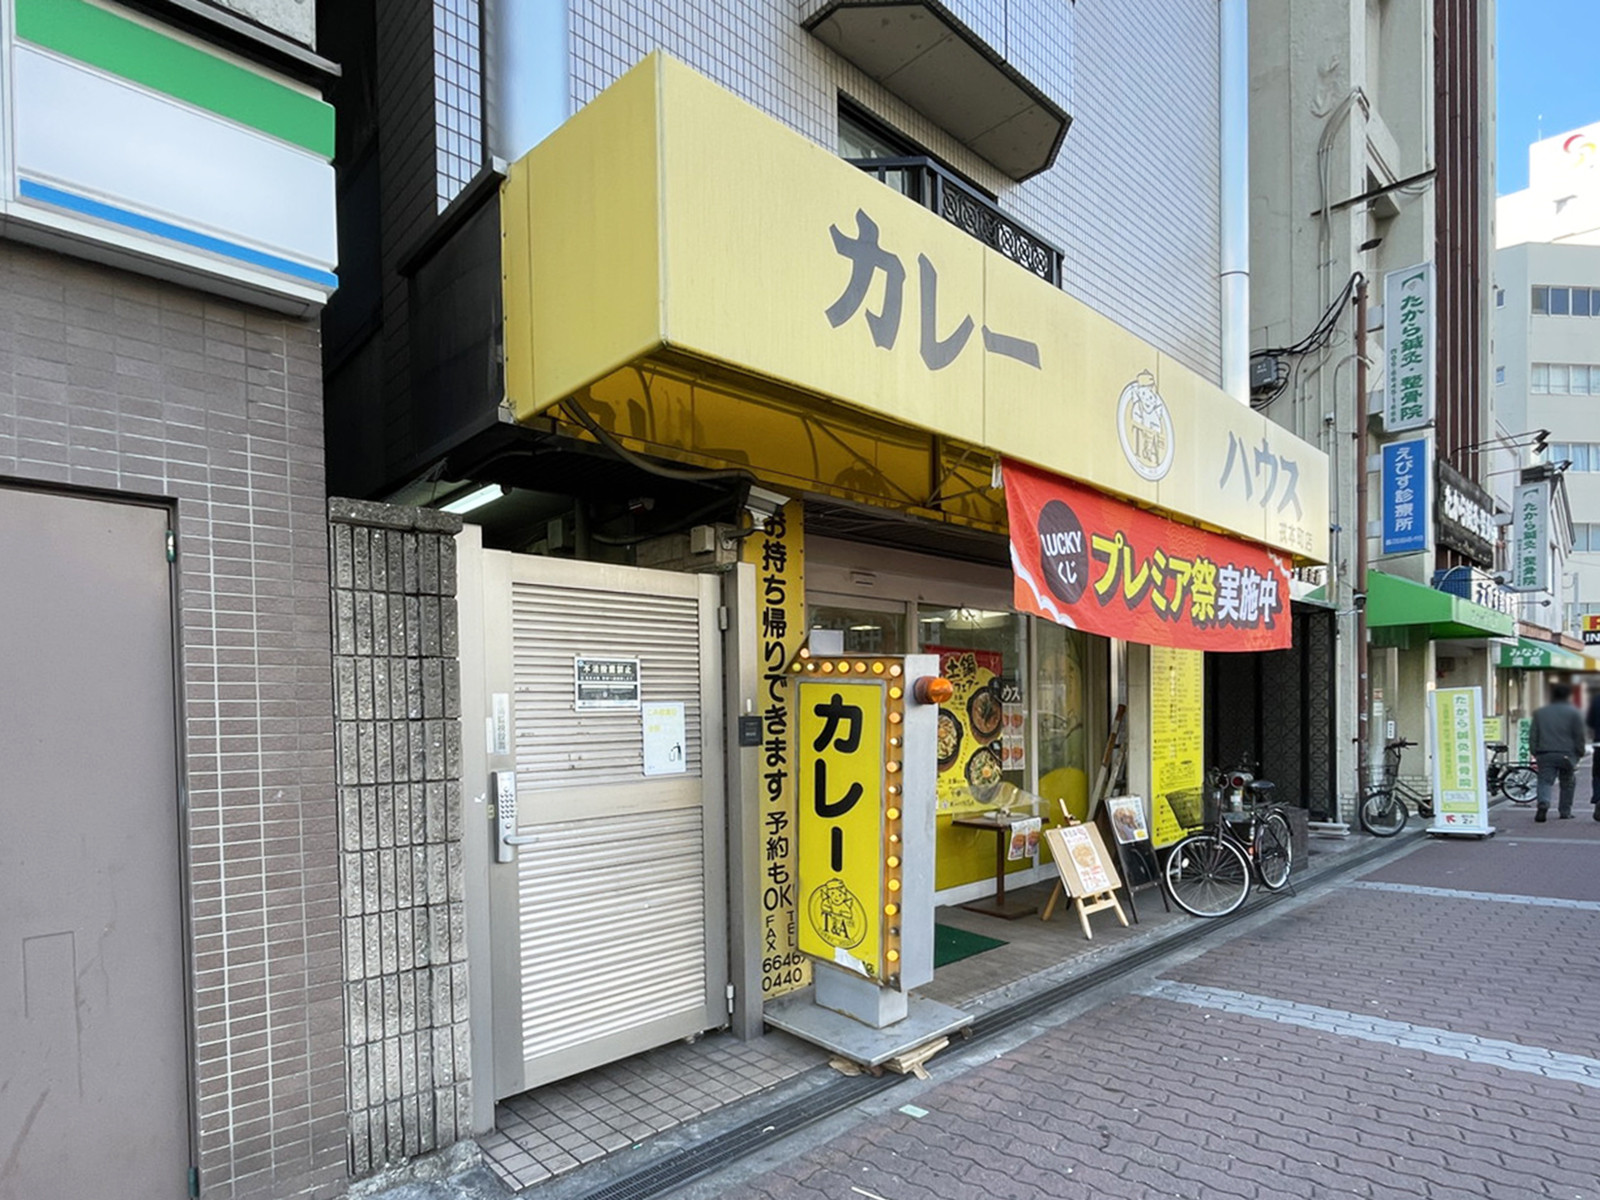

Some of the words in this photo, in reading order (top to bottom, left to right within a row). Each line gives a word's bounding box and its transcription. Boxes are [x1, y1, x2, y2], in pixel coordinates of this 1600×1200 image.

[824, 207, 1042, 371] カレー
[1400, 295, 1425, 421] たから鍼灸・整骨院
[1219, 430, 1303, 522] ハウス
[1394, 447, 1414, 532] えびす診療所
[1040, 530, 1082, 557] LUCKY
[1057, 560, 1078, 585] くじ
[1091, 531, 1279, 623] プレミア祭実施中
[762, 512, 788, 801] お持ち帰りできます
[946, 653, 977, 679] 土鍋
[1509, 647, 1544, 657] みなみ
[813, 693, 864, 873] カレー
[765, 914, 777, 953] FAX
[786, 910, 795, 947] TEL
[821, 911, 851, 941] T&A
[761, 967, 803, 992] 0440
